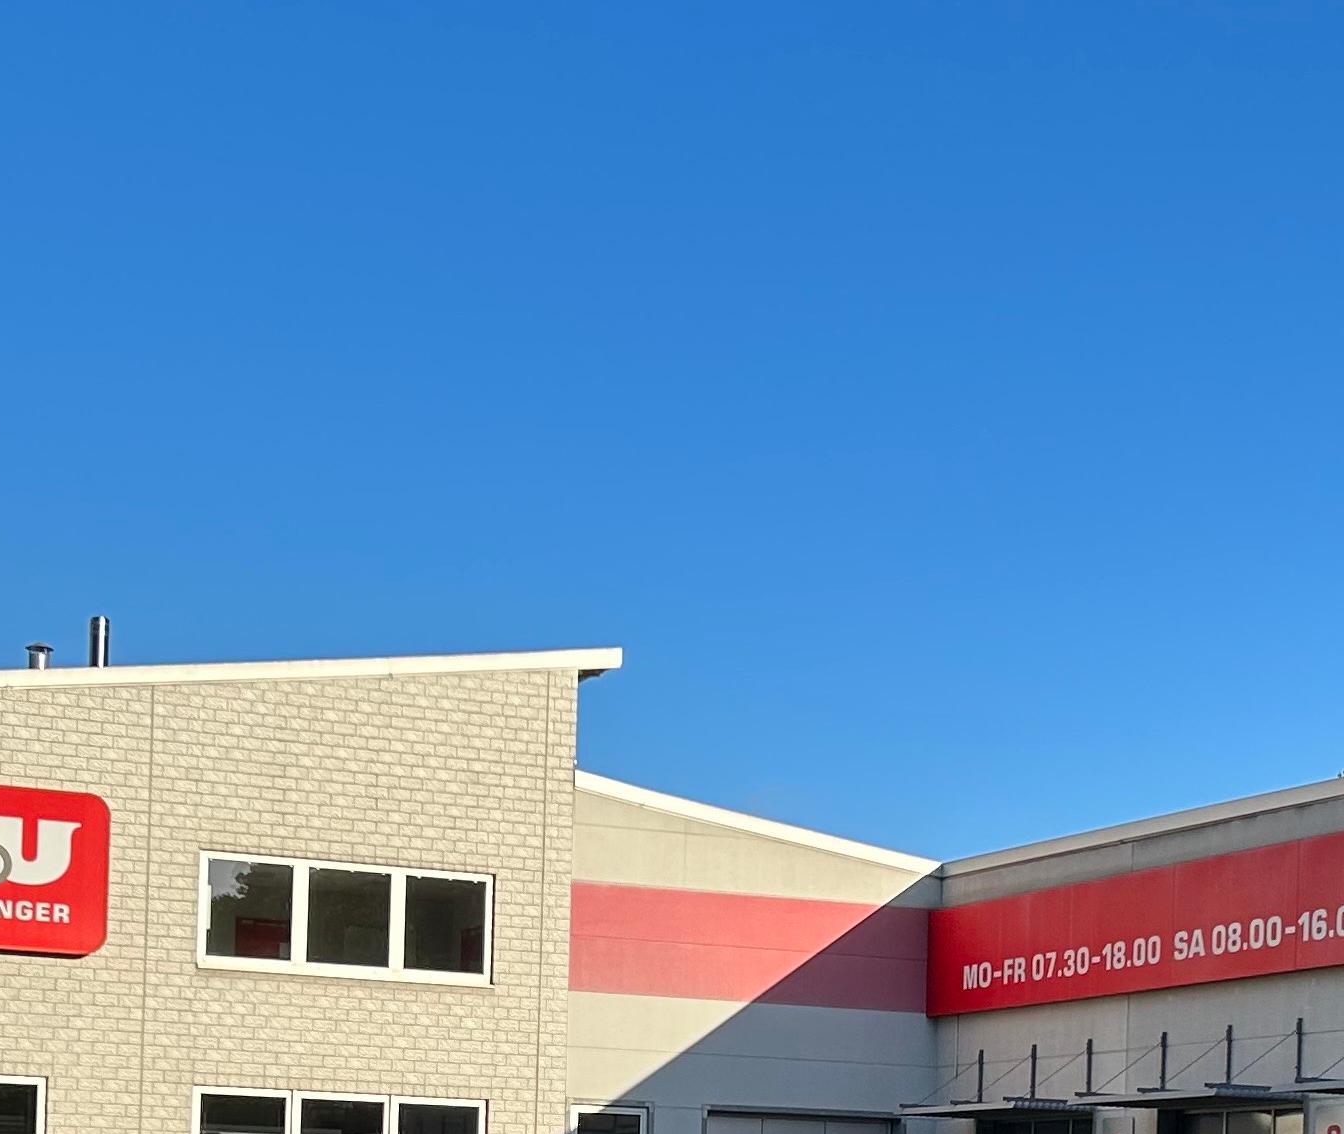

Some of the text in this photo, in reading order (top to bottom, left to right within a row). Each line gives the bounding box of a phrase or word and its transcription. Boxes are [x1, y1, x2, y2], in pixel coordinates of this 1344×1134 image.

[962, 957, 1026, 990] MO-FR
[1032, 935, 1161, 982] 07.30-18.00
[1174, 928, 1206, 961] SA
